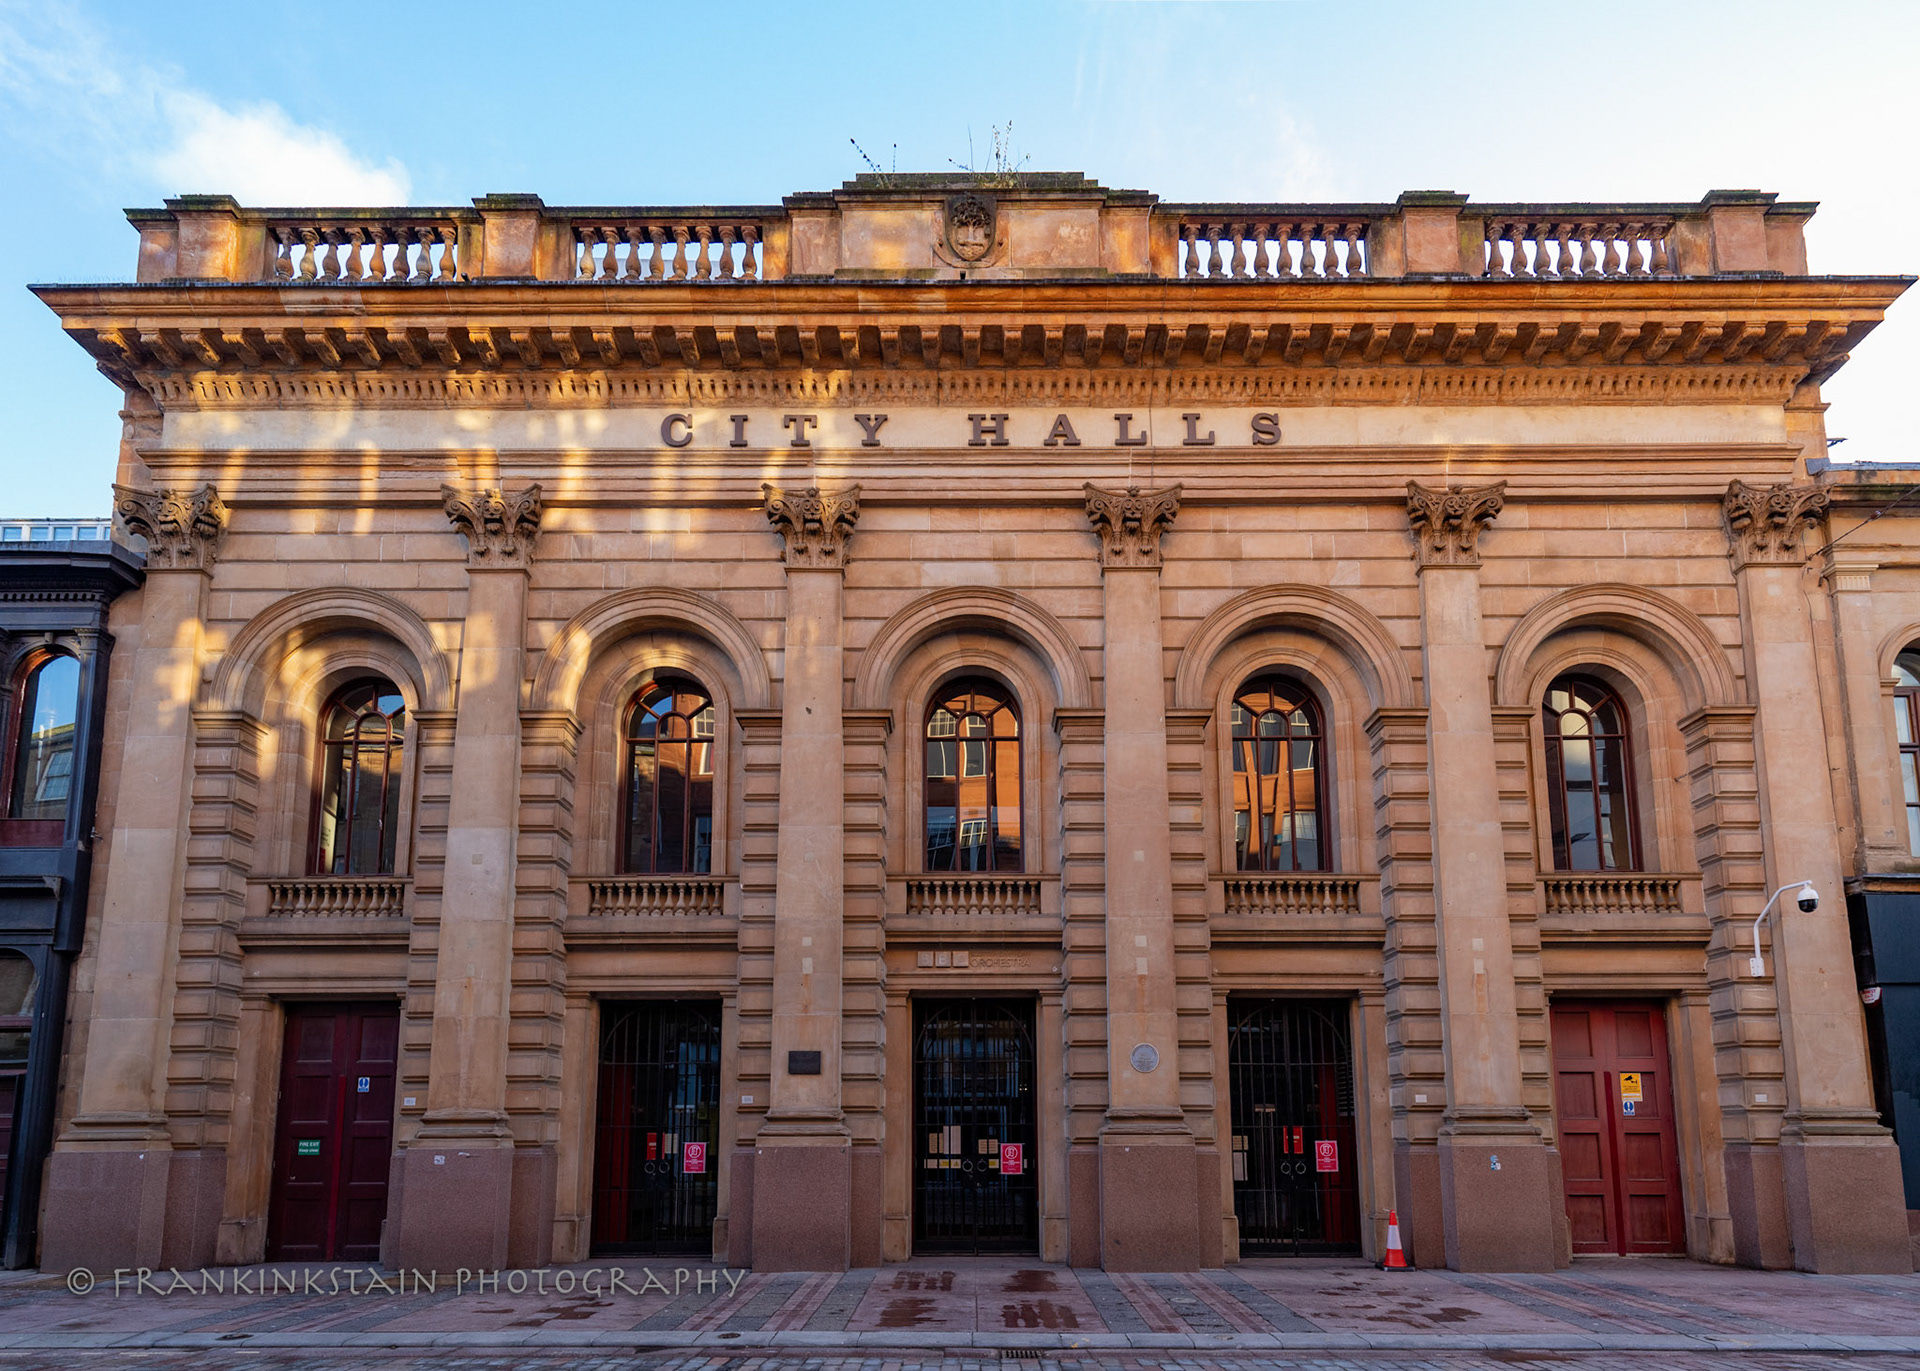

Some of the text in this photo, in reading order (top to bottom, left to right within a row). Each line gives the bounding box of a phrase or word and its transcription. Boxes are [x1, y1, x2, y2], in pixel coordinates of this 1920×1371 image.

[661, 412, 1282, 447] CITY HALLS
[970, 958, 1031, 967] ORCHESTRA
